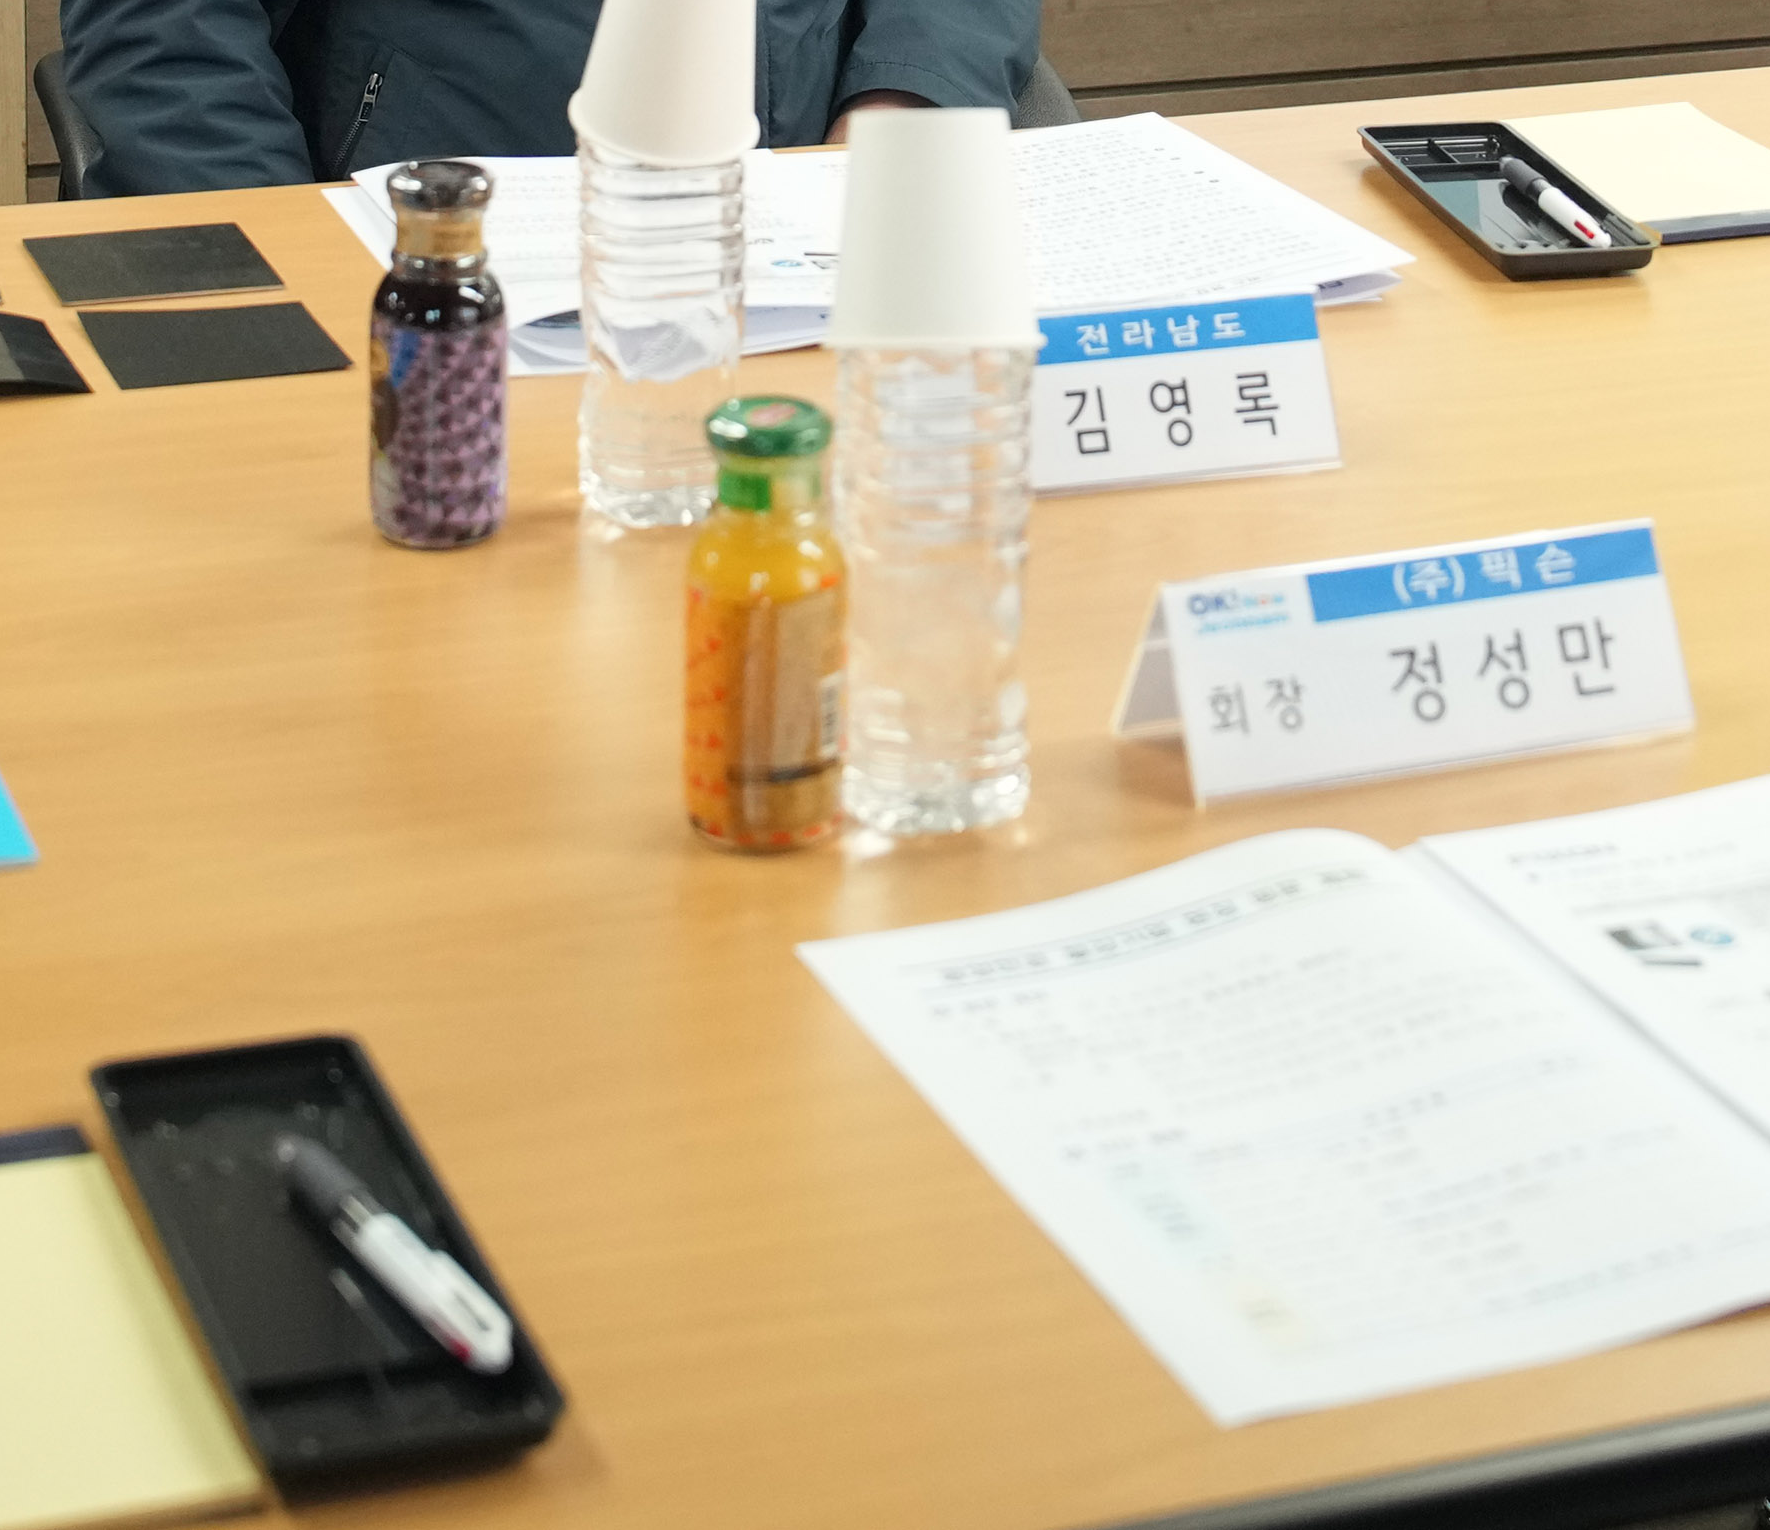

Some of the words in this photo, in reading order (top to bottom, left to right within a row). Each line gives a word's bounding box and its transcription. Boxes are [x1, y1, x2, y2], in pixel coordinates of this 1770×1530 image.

[1076, 311, 1245, 356] 전라남도
[1064, 370, 1280, 455] 김영록
[1392, 555, 1465, 604] (주)
[1479, 543, 1577, 590] 픽슨
[1389, 617, 1616, 724] 정성만
[1209, 675, 1306, 736] 회장
